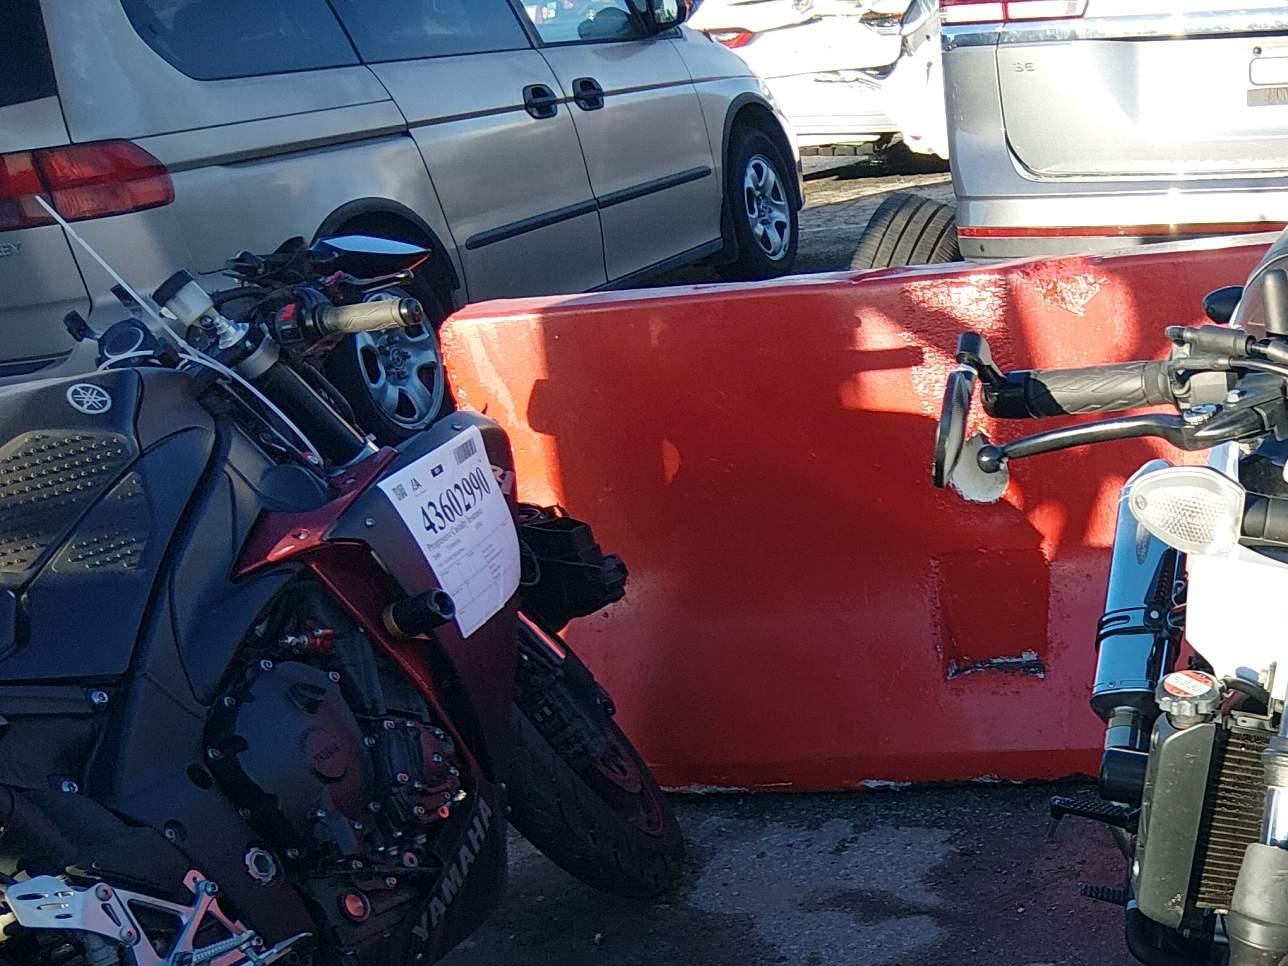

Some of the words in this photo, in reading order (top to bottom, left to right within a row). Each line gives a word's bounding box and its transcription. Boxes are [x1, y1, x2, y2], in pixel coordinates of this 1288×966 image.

[1015, 62, 1036, 73] SE
[420, 466, 491, 535] 43602990
[411, 796, 493, 942] YAMAHA
